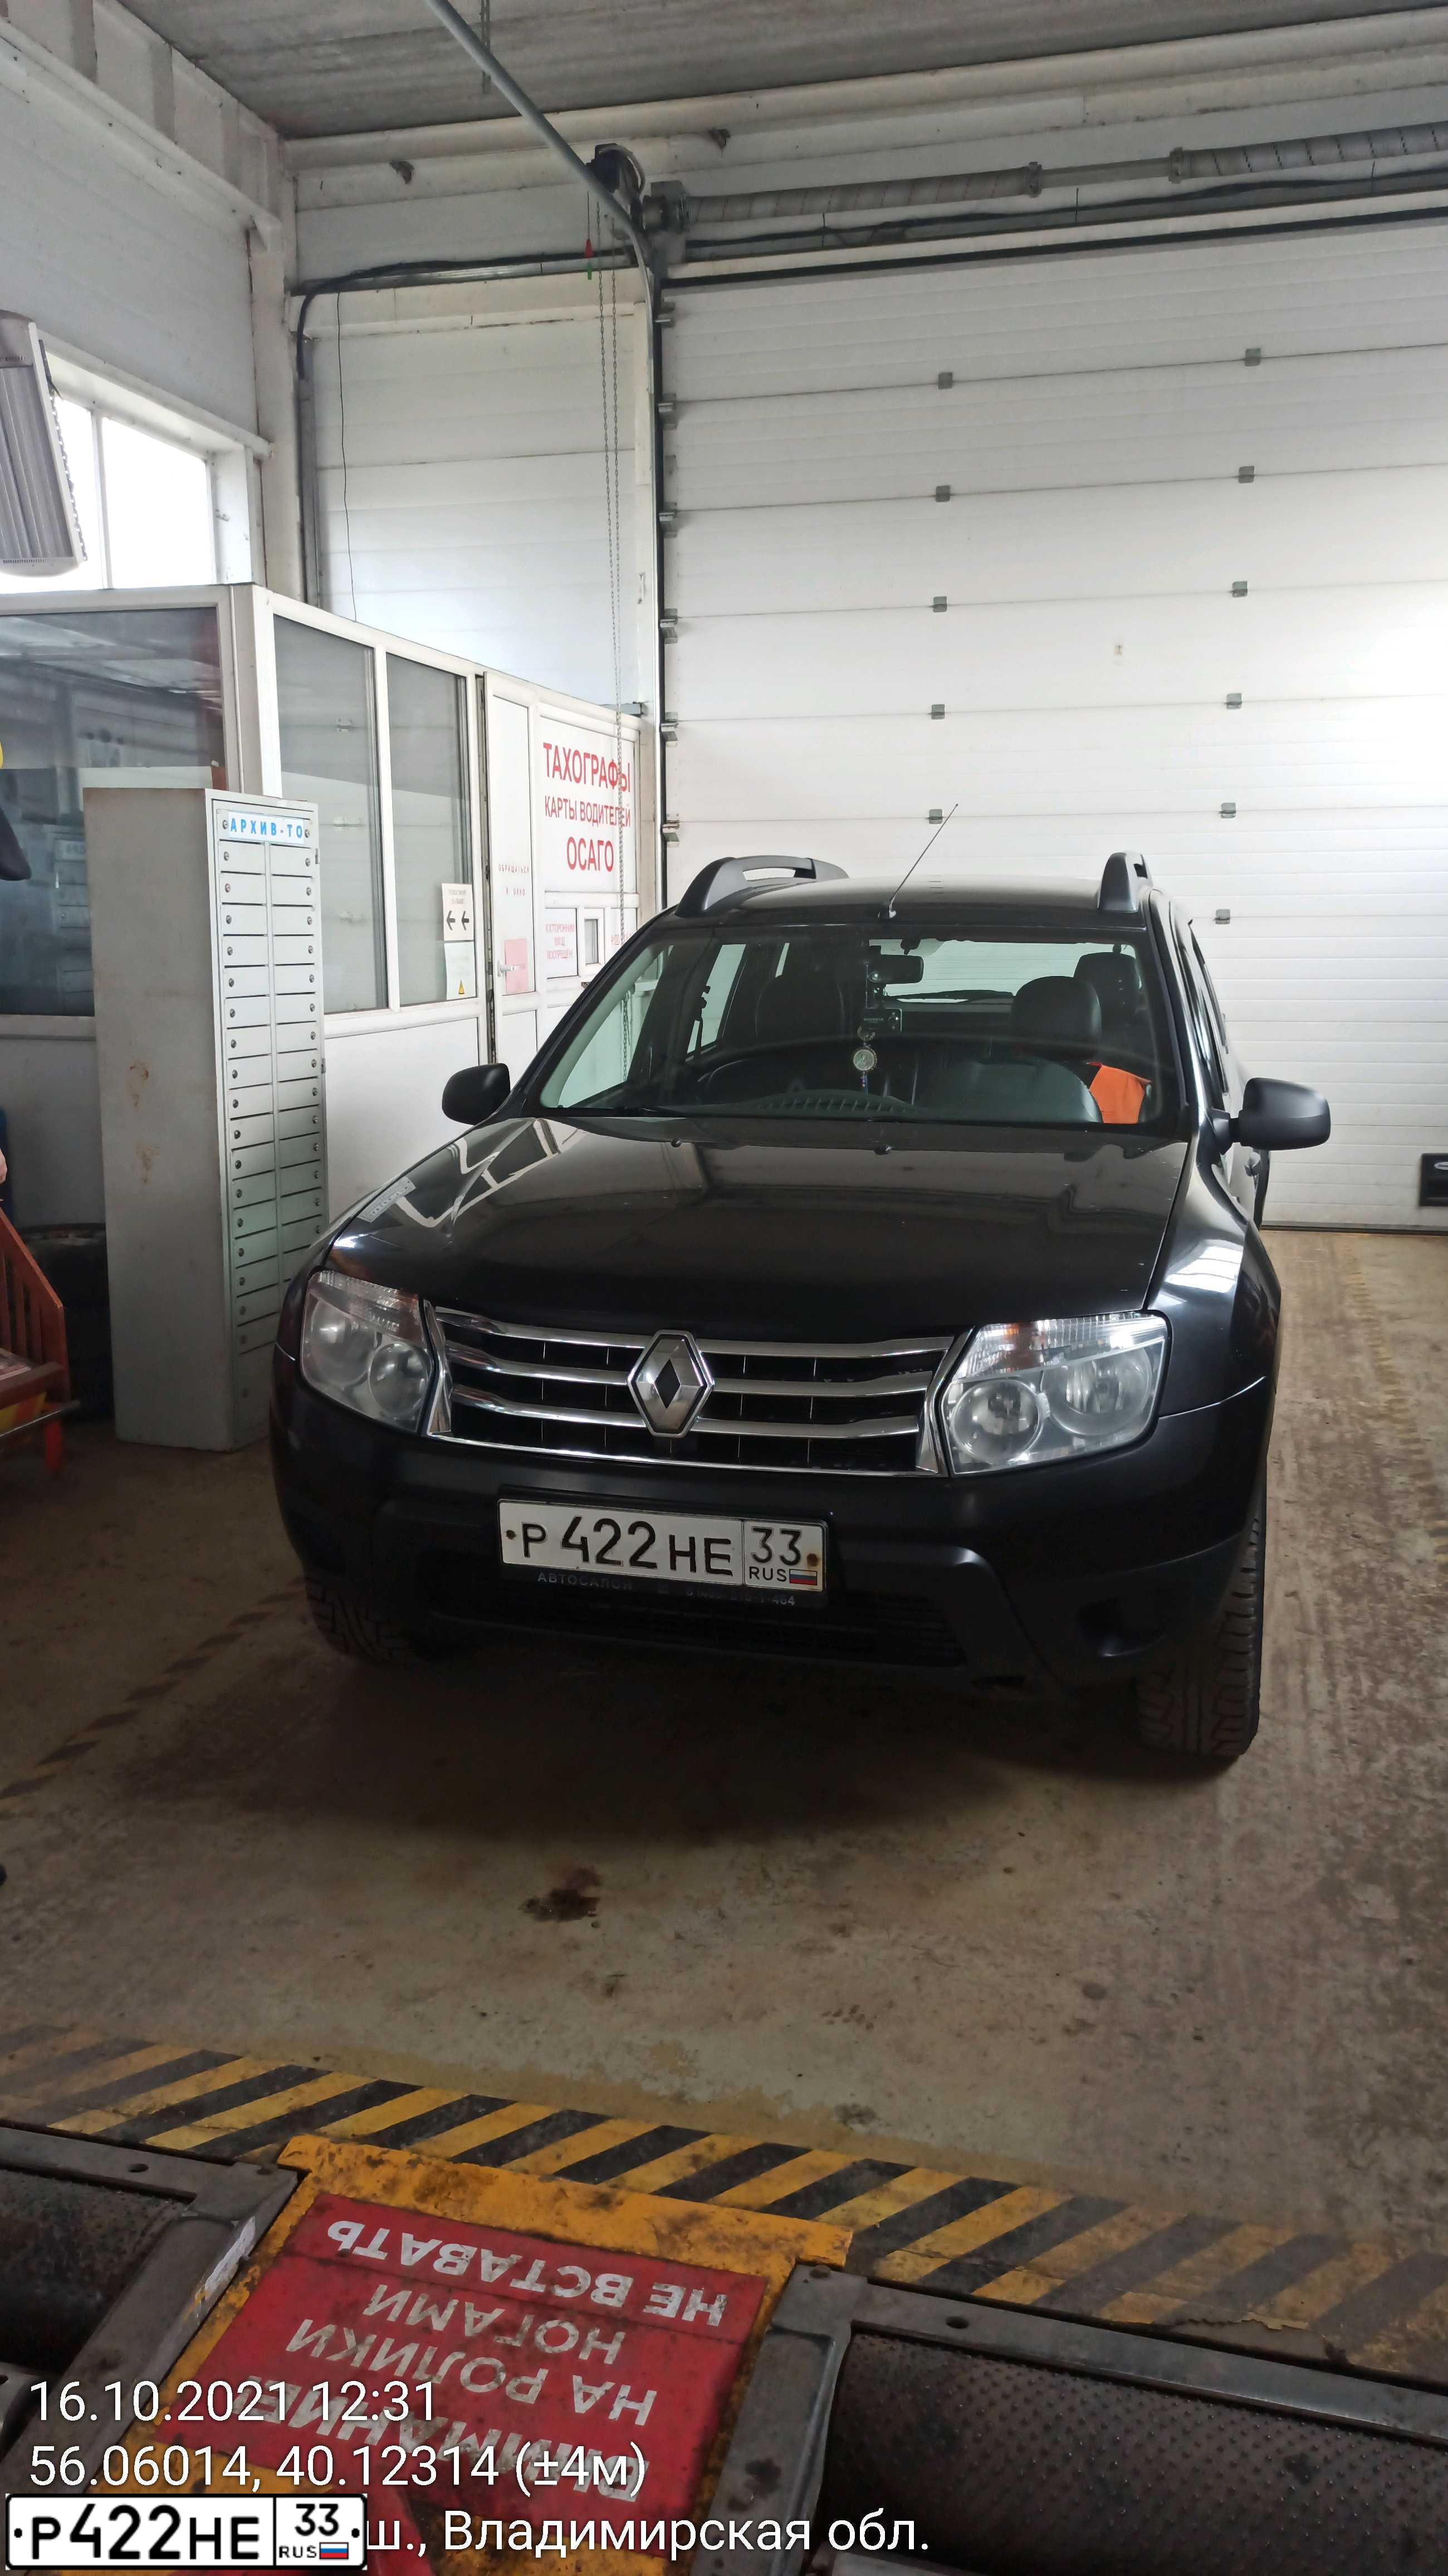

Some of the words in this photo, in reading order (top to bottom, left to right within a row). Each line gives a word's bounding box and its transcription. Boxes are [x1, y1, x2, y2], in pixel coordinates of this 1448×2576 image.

[543, 742, 630, 792] ТАХОГРАФЫ
[545, 796, 577, 821] КАРТЫ
[580, 801, 631, 827] ВОДИТЕЛЕЙ
[567, 837, 614, 872] ОСАГО
[751, 1528, 802, 1565] 33
[749, 1566, 787, 1583] RUS
[327, 2221, 634, 2308] ВСТАВАТЬ
[363, 2284, 626, 2365] НОГАМИ
[643, 2283, 727, 2326] НЕ
[286, 2319, 548, 2404] РОЛИКИ
[572, 2374, 657, 2426] НА
